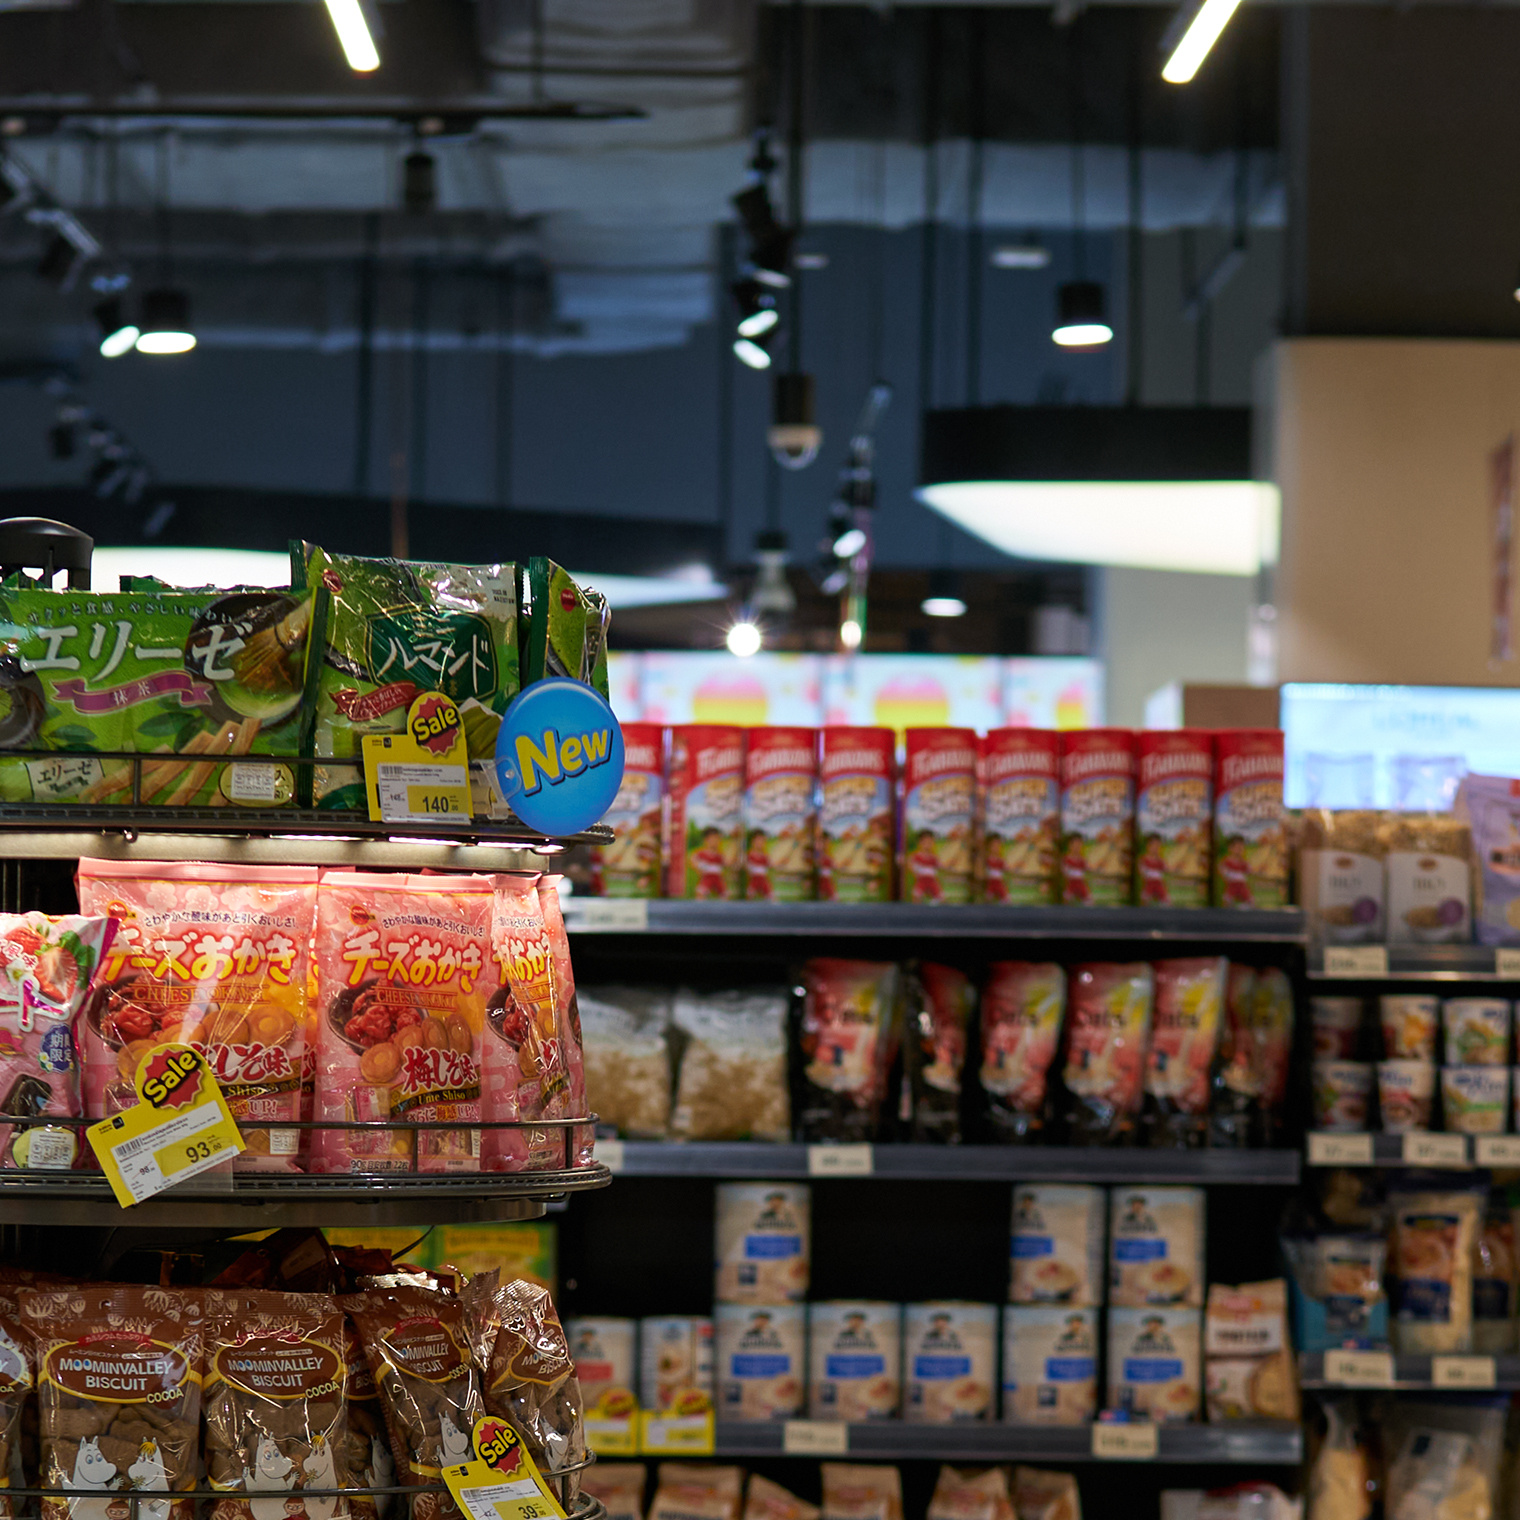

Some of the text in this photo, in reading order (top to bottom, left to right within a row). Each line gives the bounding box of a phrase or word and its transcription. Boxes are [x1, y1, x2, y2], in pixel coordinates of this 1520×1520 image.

[20, 620, 253, 683] エリーゼ
[377, 633, 491, 694] ルマンド
[411, 705, 459, 741] Sale
[514, 728, 614, 797] New
[106, 931, 297, 984] チーズおかき
[342, 930, 482, 994] チーズおかき
[142, 1050, 202, 1110] Sale
[58, 1356, 175, 1376] MOOMINVALLEY
[85, 1374, 148, 1392] BISCUIT
[228, 1355, 325, 1374] MOOMINVALLEY
[252, 1372, 305, 1389] BISCUIT
[147, 1388, 184, 1403] COCOA
[481, 1424, 518, 1467] Sale
